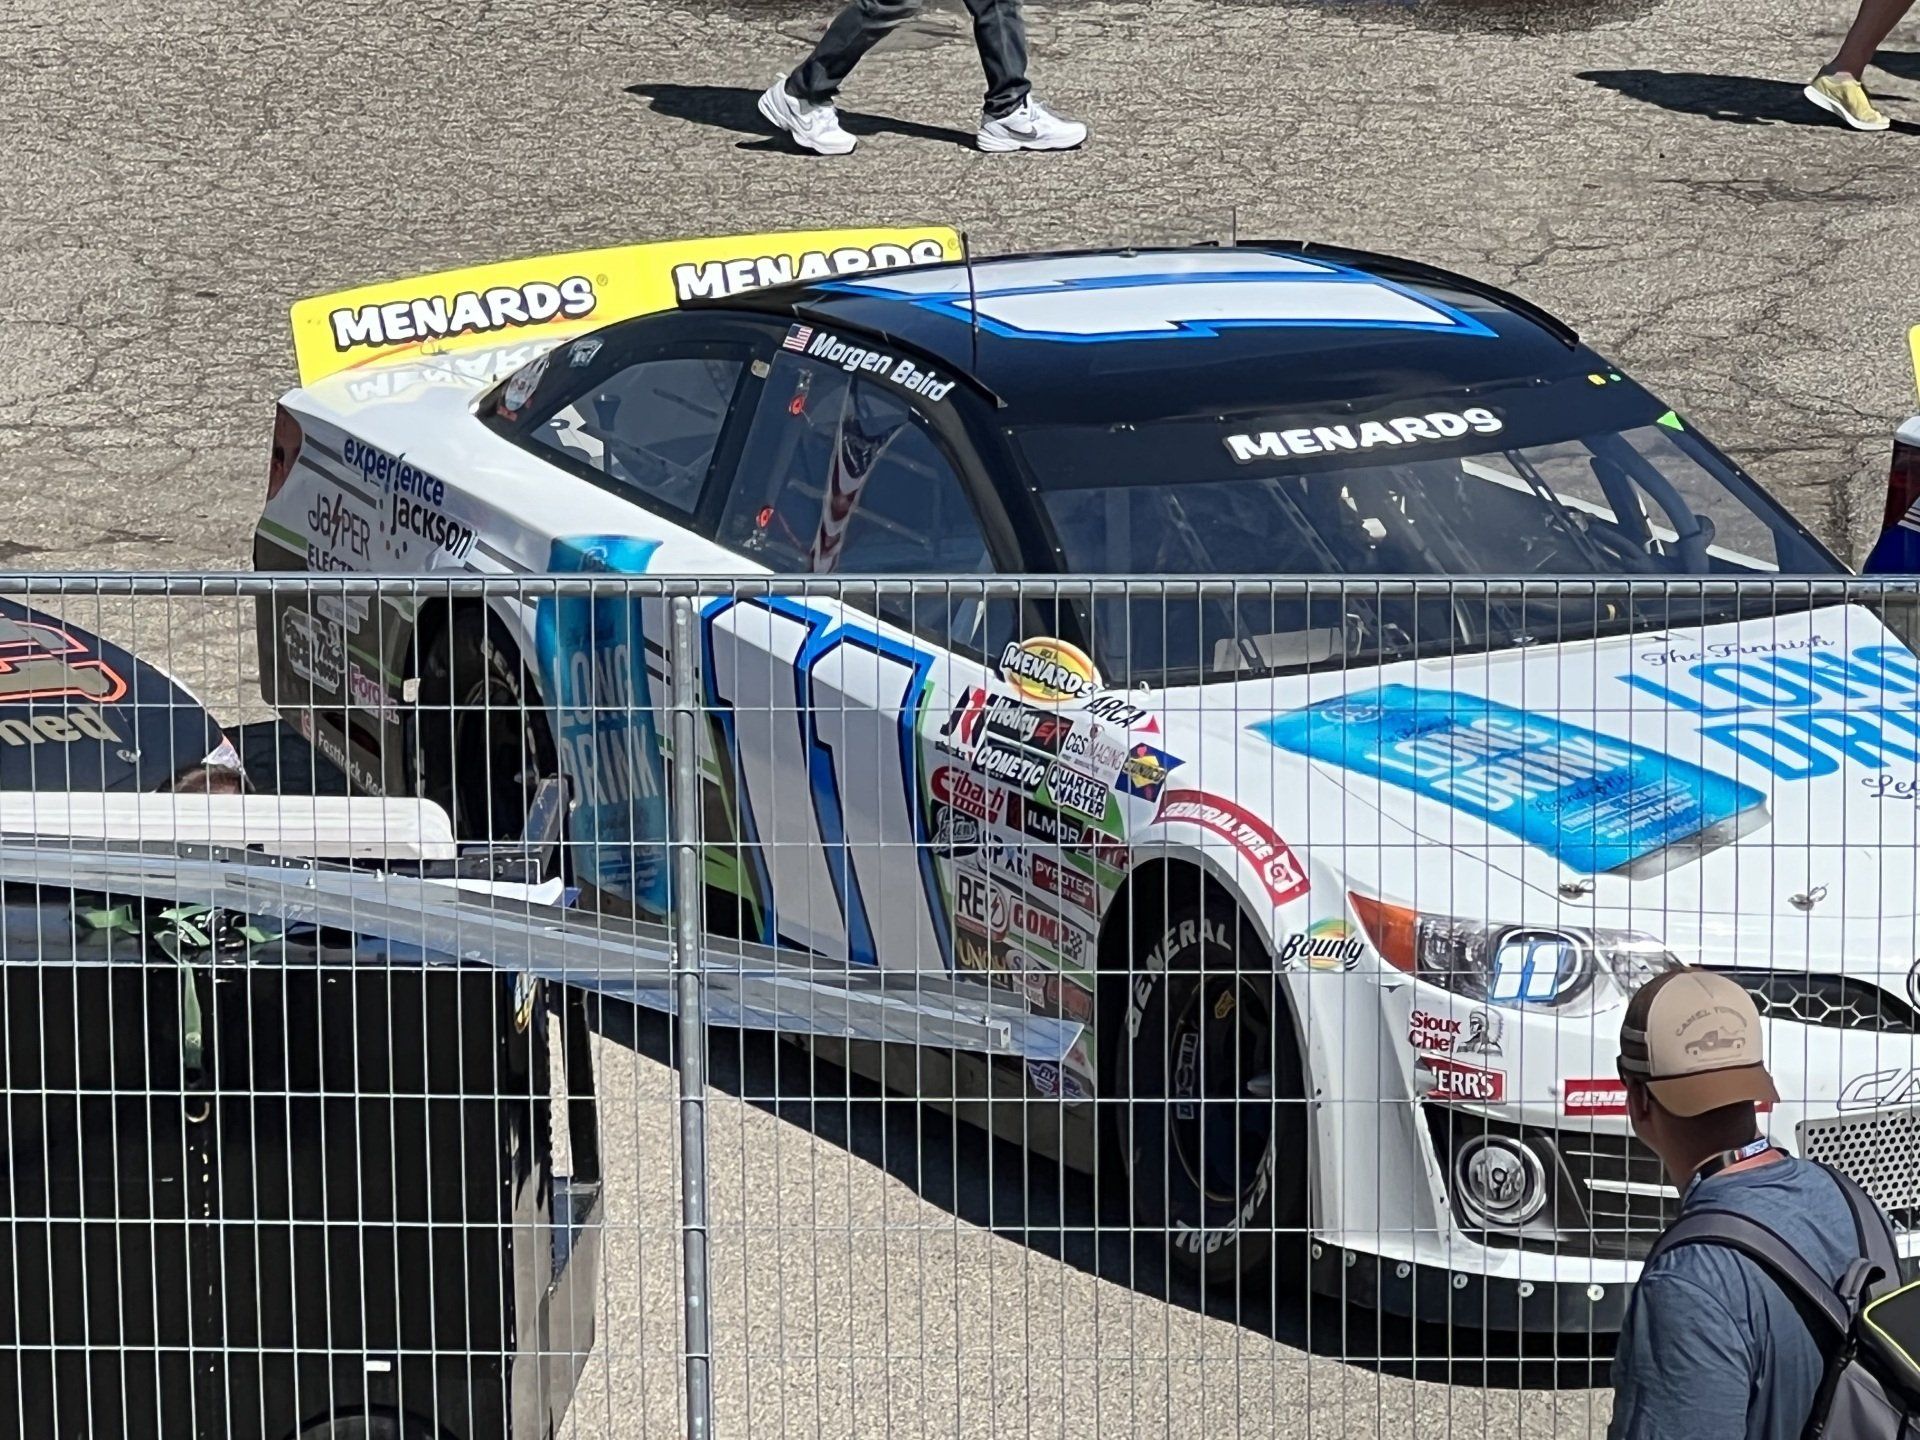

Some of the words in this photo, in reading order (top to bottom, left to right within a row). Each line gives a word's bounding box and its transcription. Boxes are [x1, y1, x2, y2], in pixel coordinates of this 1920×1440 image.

[676, 240, 945, 303] MENARDS
[329, 276, 596, 352] MENARDS
[808, 332, 893, 374] Morgen
[890, 358, 956, 401] Baird
[1224, 406, 1504, 464] MENARDS
[343, 437, 445, 505] experience
[1001, 645, 1098, 698] MENARDS
[1082, 696, 1148, 729] ARCA
[976, 745, 1045, 786] COMETIC
[1362, 718, 1550, 777] LONG
[1048, 764, 1106, 800] QUARTER
[1430, 735, 1647, 812] DRINK
[1027, 809, 1080, 845] ILMOR
[1160, 802, 1236, 832] GENERAL
[1231, 823, 1274, 861] TIRE
[1013, 903, 1070, 945] COMP
[1281, 932, 1365, 972] Bounty
[1408, 1030, 1456, 1053] Chief
[1410, 1010, 1462, 1036] Sioux
[1431, 1066, 1495, 1098] ERR'S
